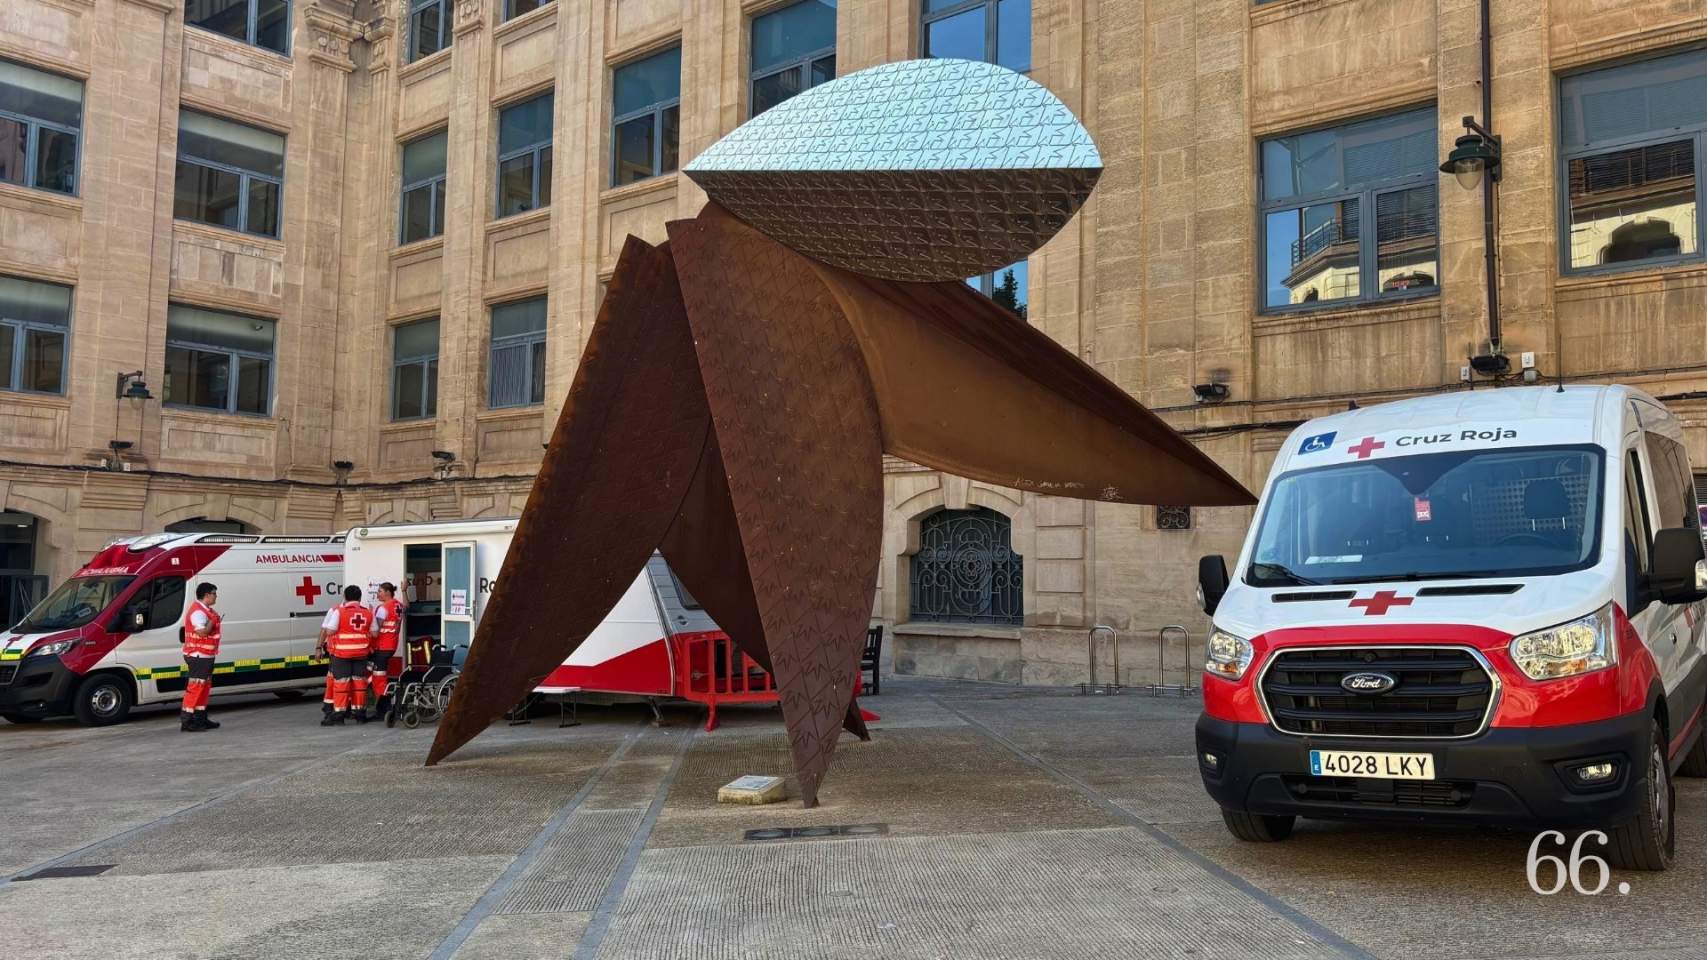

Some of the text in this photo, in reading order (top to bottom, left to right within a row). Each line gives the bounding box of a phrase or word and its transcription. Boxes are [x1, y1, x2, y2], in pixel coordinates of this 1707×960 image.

[1396, 427, 1518, 447] Cruz Roja
[256, 554, 324, 564] AMBULANCIA
[326, 581, 344, 595] Cr
[479, 577, 497, 594] Ro
[1351, 675, 1382, 689] Ford
[1325, 754, 1427, 776] 4028 LKY
